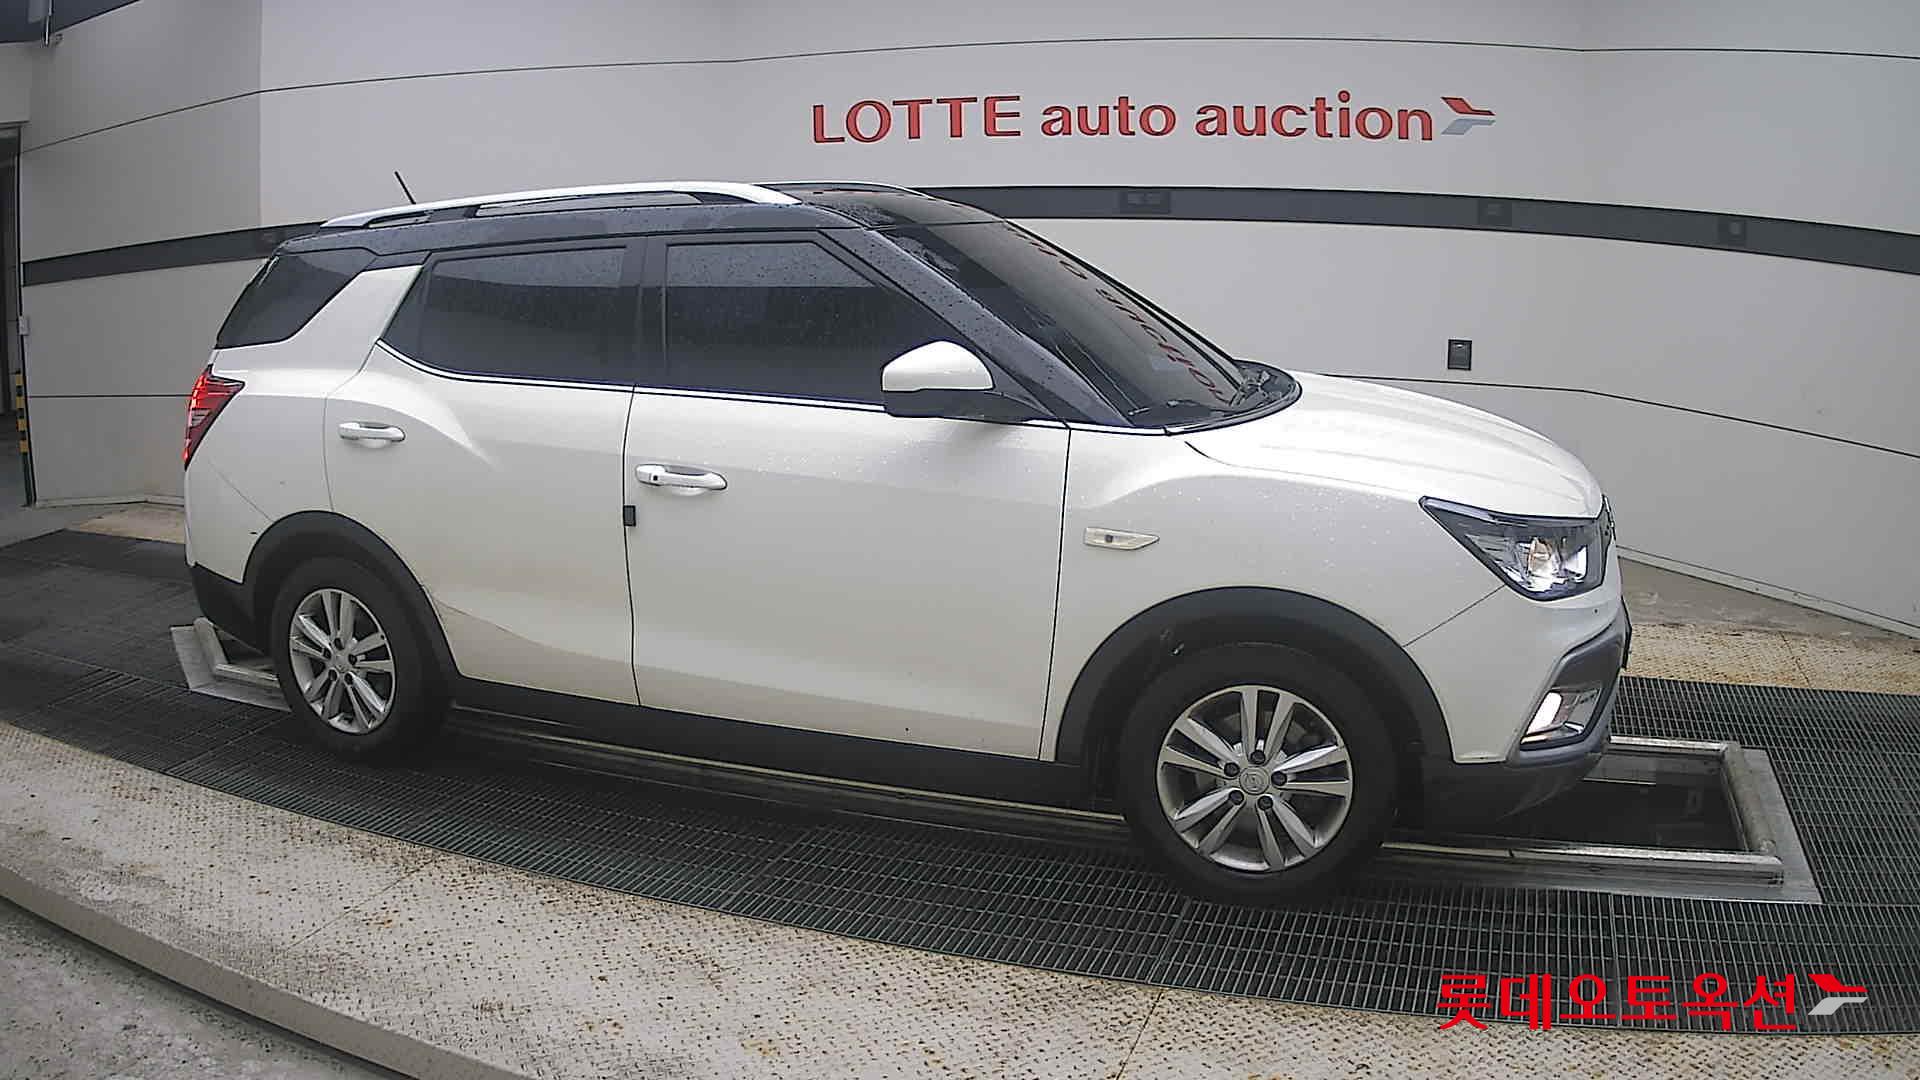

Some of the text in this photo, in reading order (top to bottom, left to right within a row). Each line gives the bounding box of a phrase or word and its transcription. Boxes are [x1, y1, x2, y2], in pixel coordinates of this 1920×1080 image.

[813, 91, 1434, 143] LOTTE auto auction
